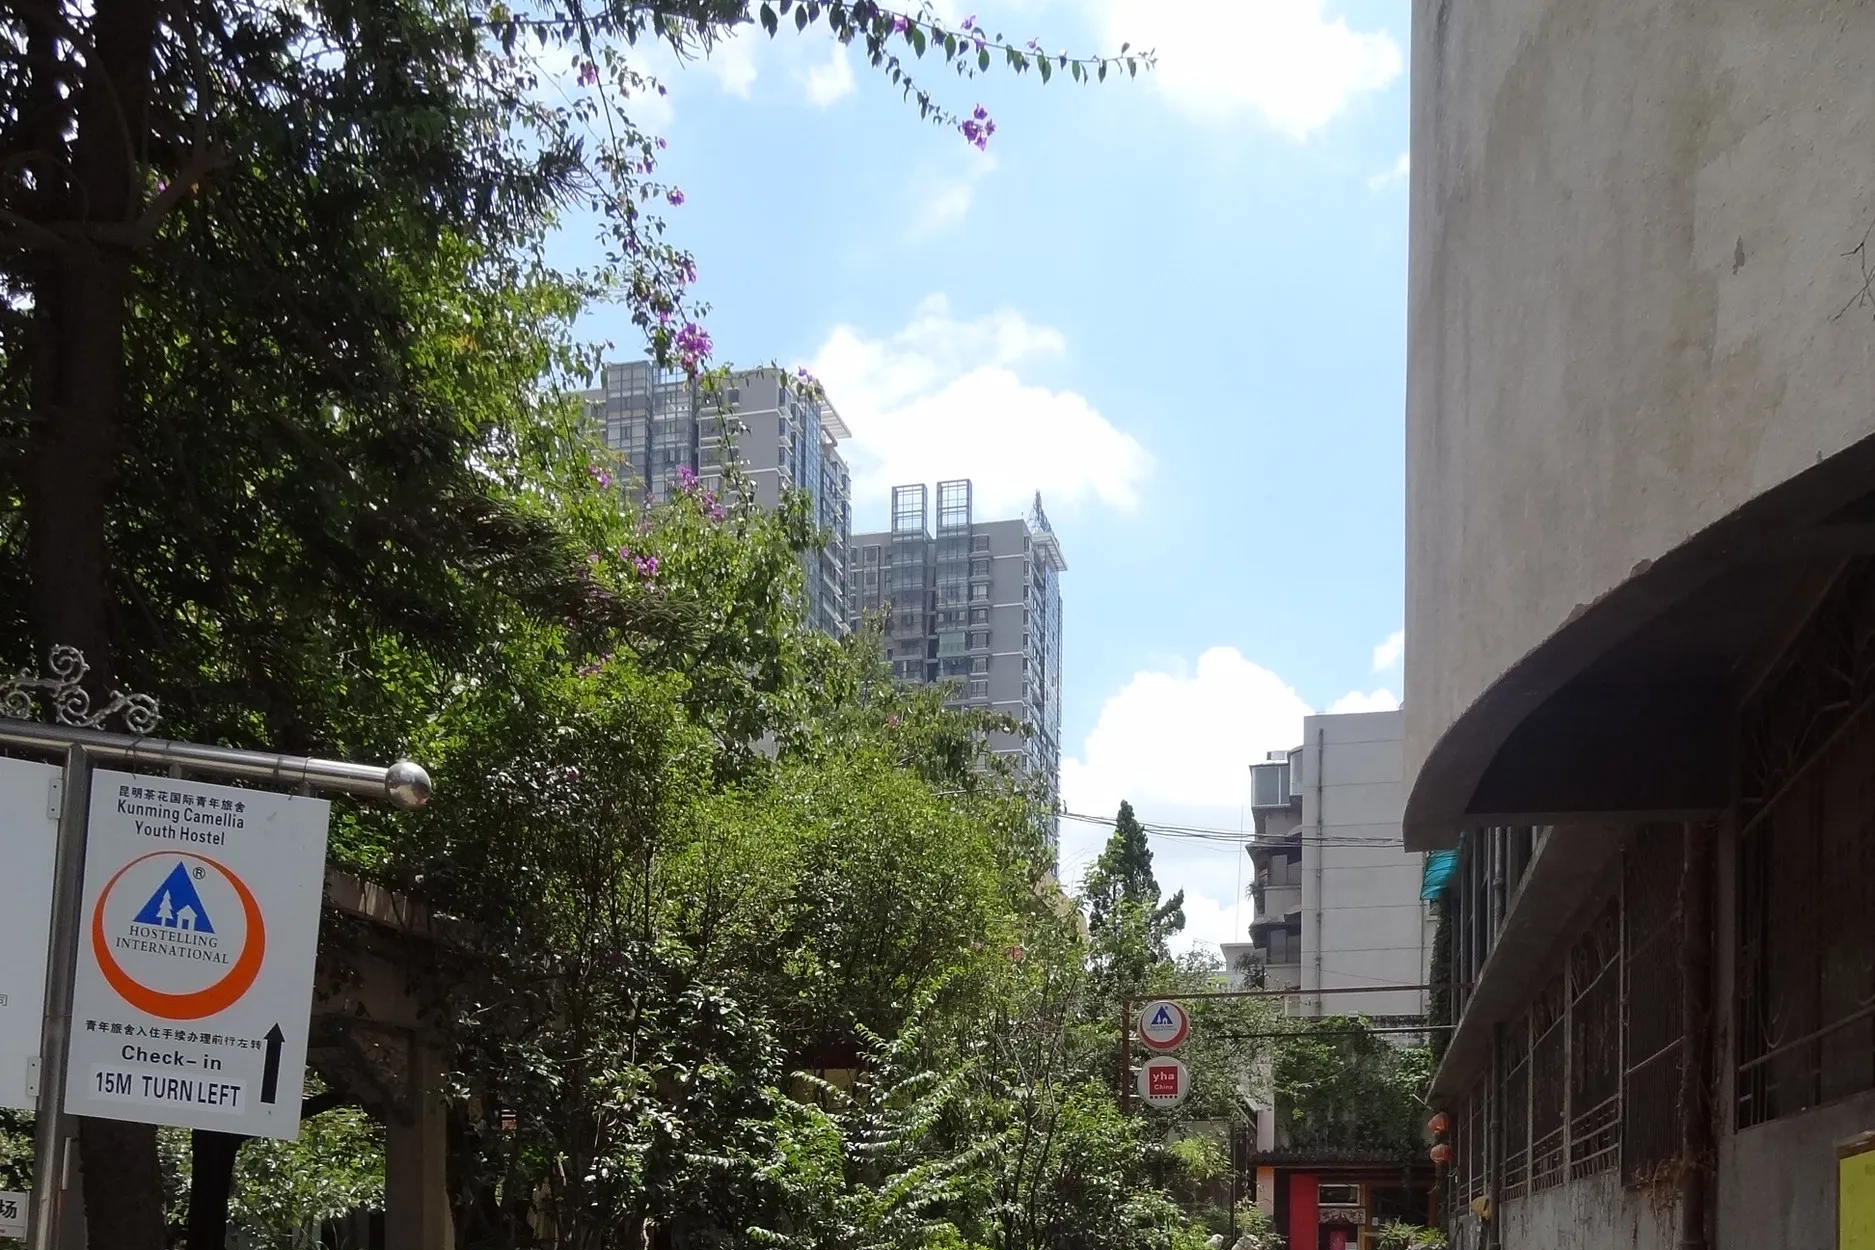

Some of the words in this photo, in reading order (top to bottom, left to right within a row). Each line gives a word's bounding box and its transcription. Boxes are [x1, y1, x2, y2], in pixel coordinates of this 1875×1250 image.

[119, 785, 246, 813] 昆明茶花国际青年旅舍
[117, 799, 180, 823] Kunming
[183, 807, 245, 829] Camellia
[135, 820, 177, 839] Youth
[180, 826, 225, 845] Hostel
[129, 925, 218, 948] HOSTELLING
[116, 937, 229, 964] INTERNATIONAL
[85, 1020, 262, 1050] 青年旅舍入住手续办理前行左转
[96, 1071, 132, 1095] 15M
[142, 1075, 193, 1102] TURN
[197, 1081, 241, 1106] LEFT
[1153, 1071, 1175, 1082] yha
[0, 1199, 17, 1219] 场
